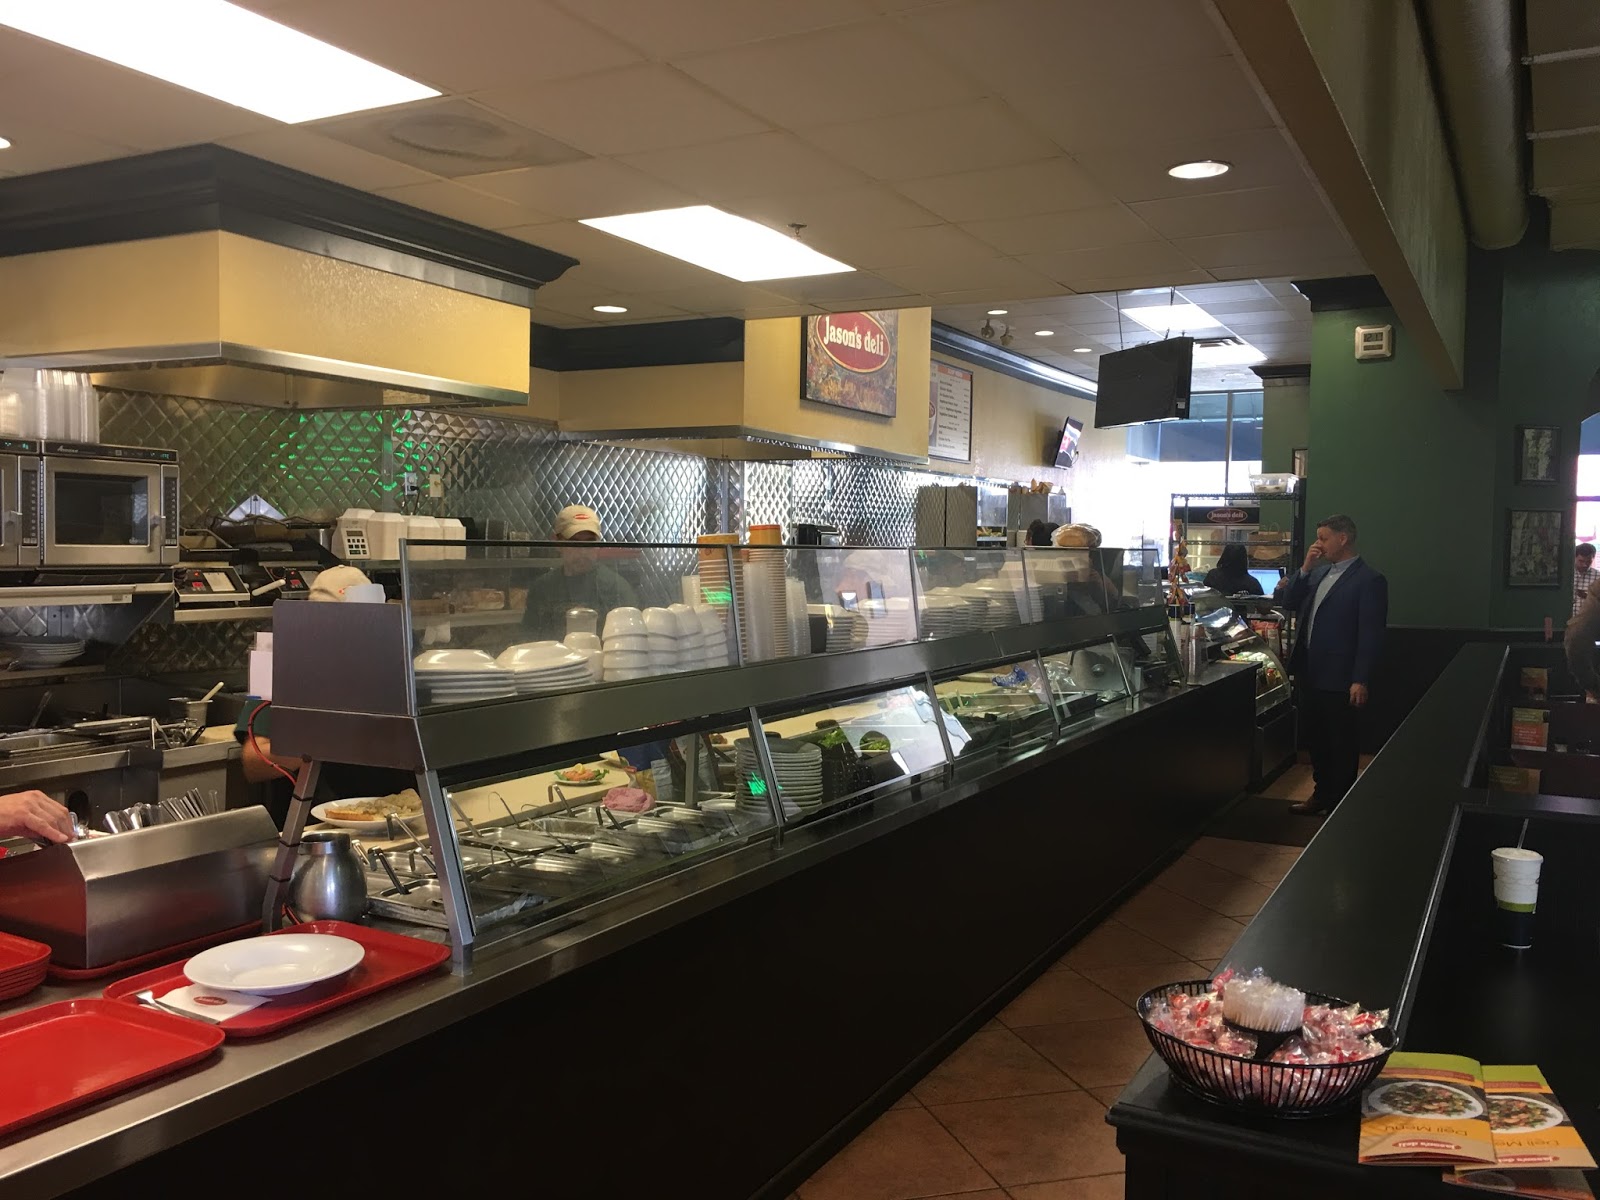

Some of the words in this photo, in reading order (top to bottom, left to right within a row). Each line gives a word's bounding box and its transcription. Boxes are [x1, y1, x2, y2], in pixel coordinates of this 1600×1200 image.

[823, 316, 862, 350] Jason's
[864, 331, 884, 356] deli
[1385, 1125, 1431, 1133] Menu
[1437, 1126, 1468, 1137] Deli
[1420, 1141, 1455, 1150] Jason's
[1495, 1139, 1522, 1147] Me
[1526, 1138, 1560, 1147] Deli
